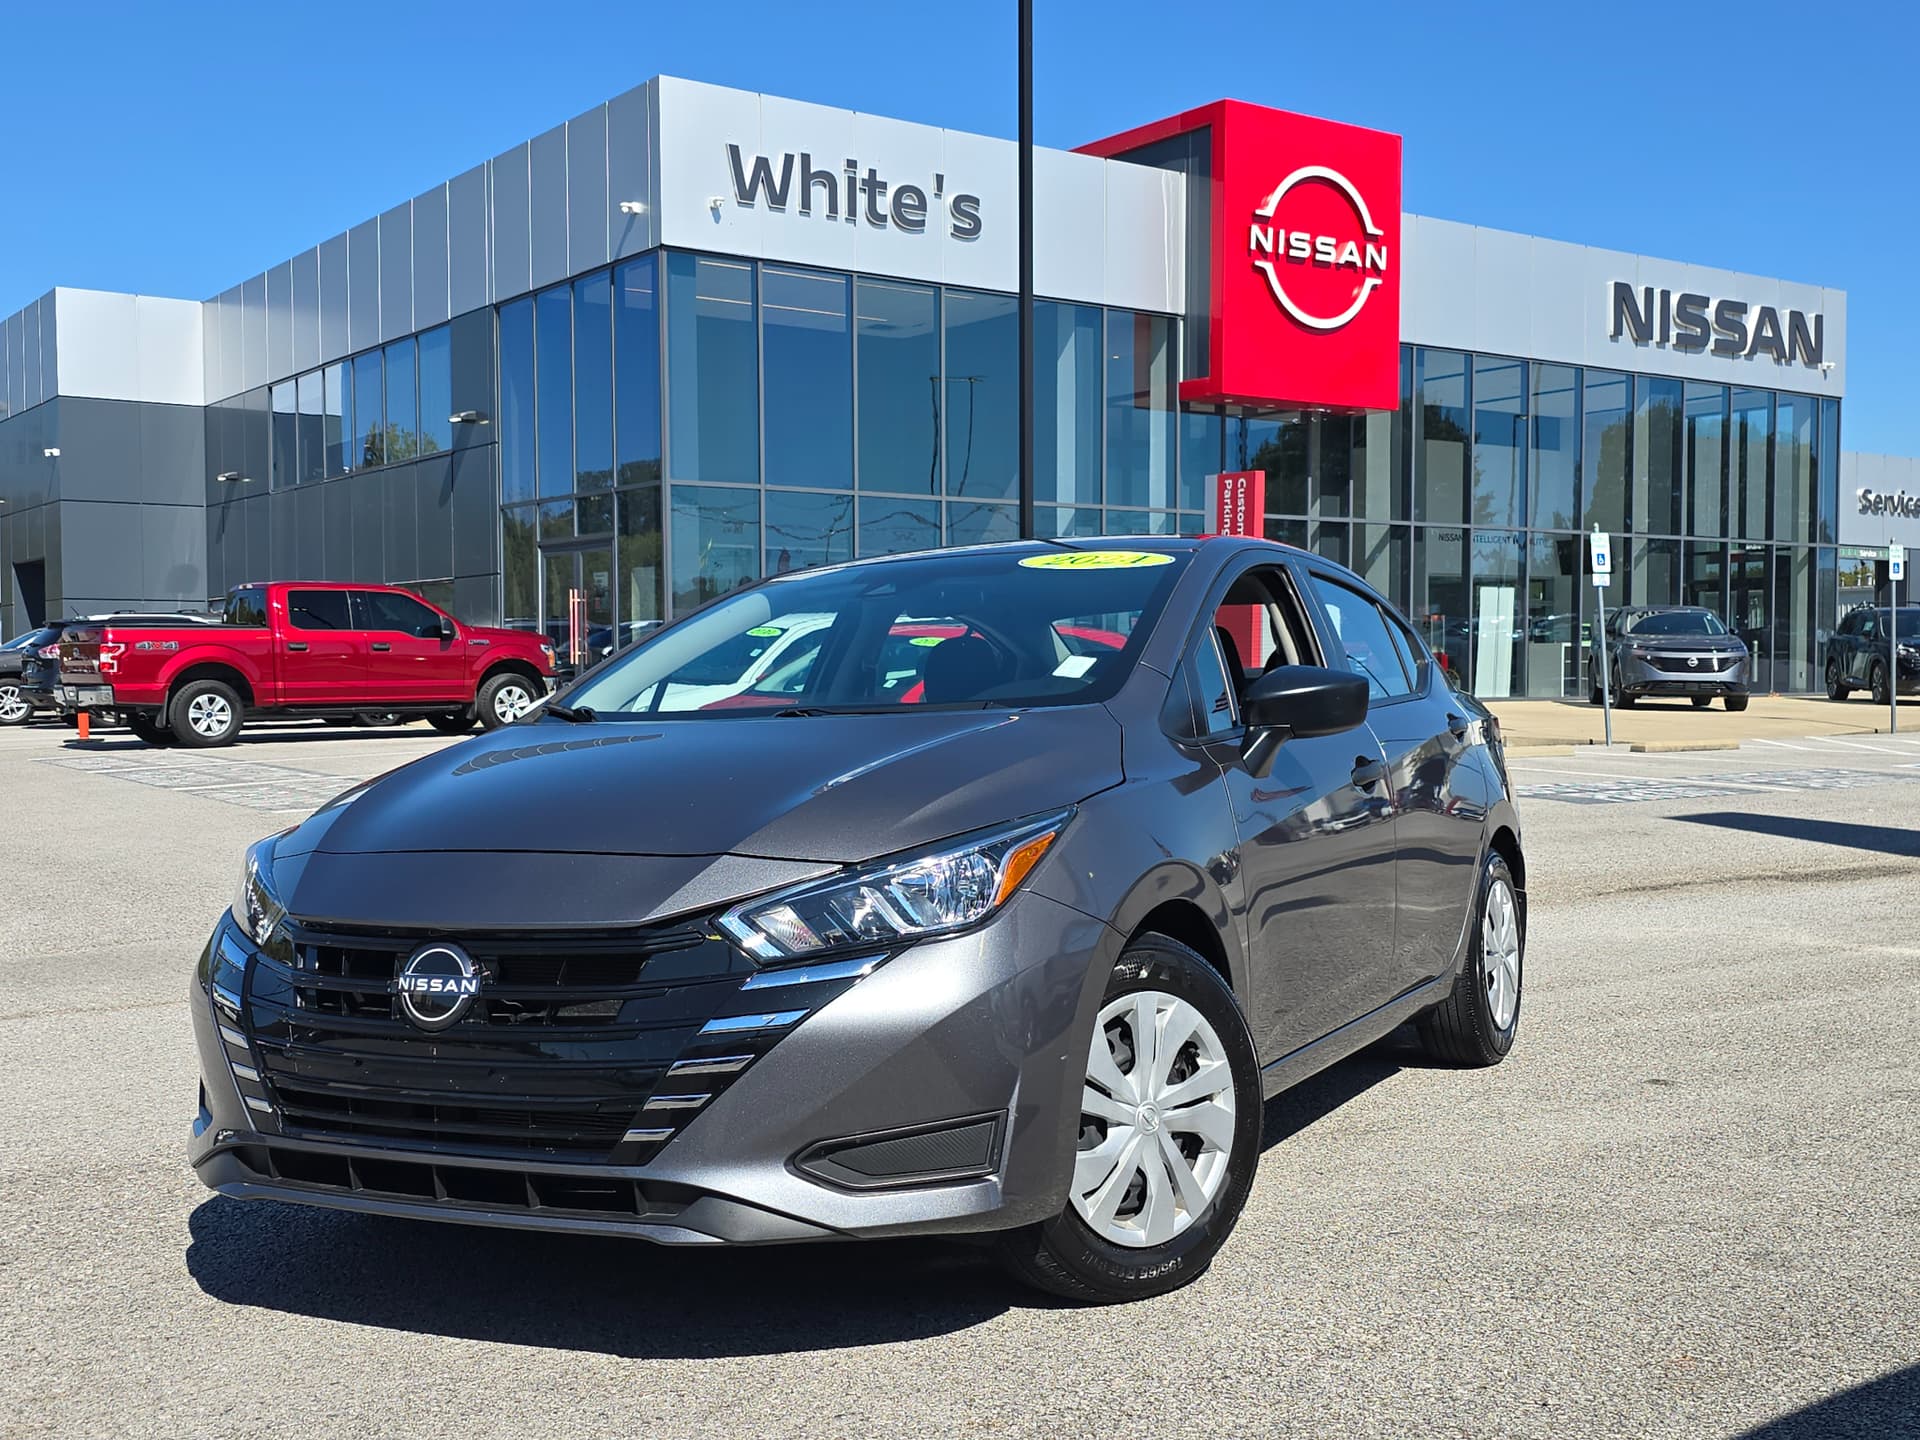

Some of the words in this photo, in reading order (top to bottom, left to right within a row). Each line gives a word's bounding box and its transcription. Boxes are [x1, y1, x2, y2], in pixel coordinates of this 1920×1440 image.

[727, 143, 983, 239] White's
[1249, 223, 1388, 271] NISSAN
[1611, 281, 1824, 365] NISSAN
[1858, 488, 1920, 517] Service
[398, 977, 478, 993] NISSAN
